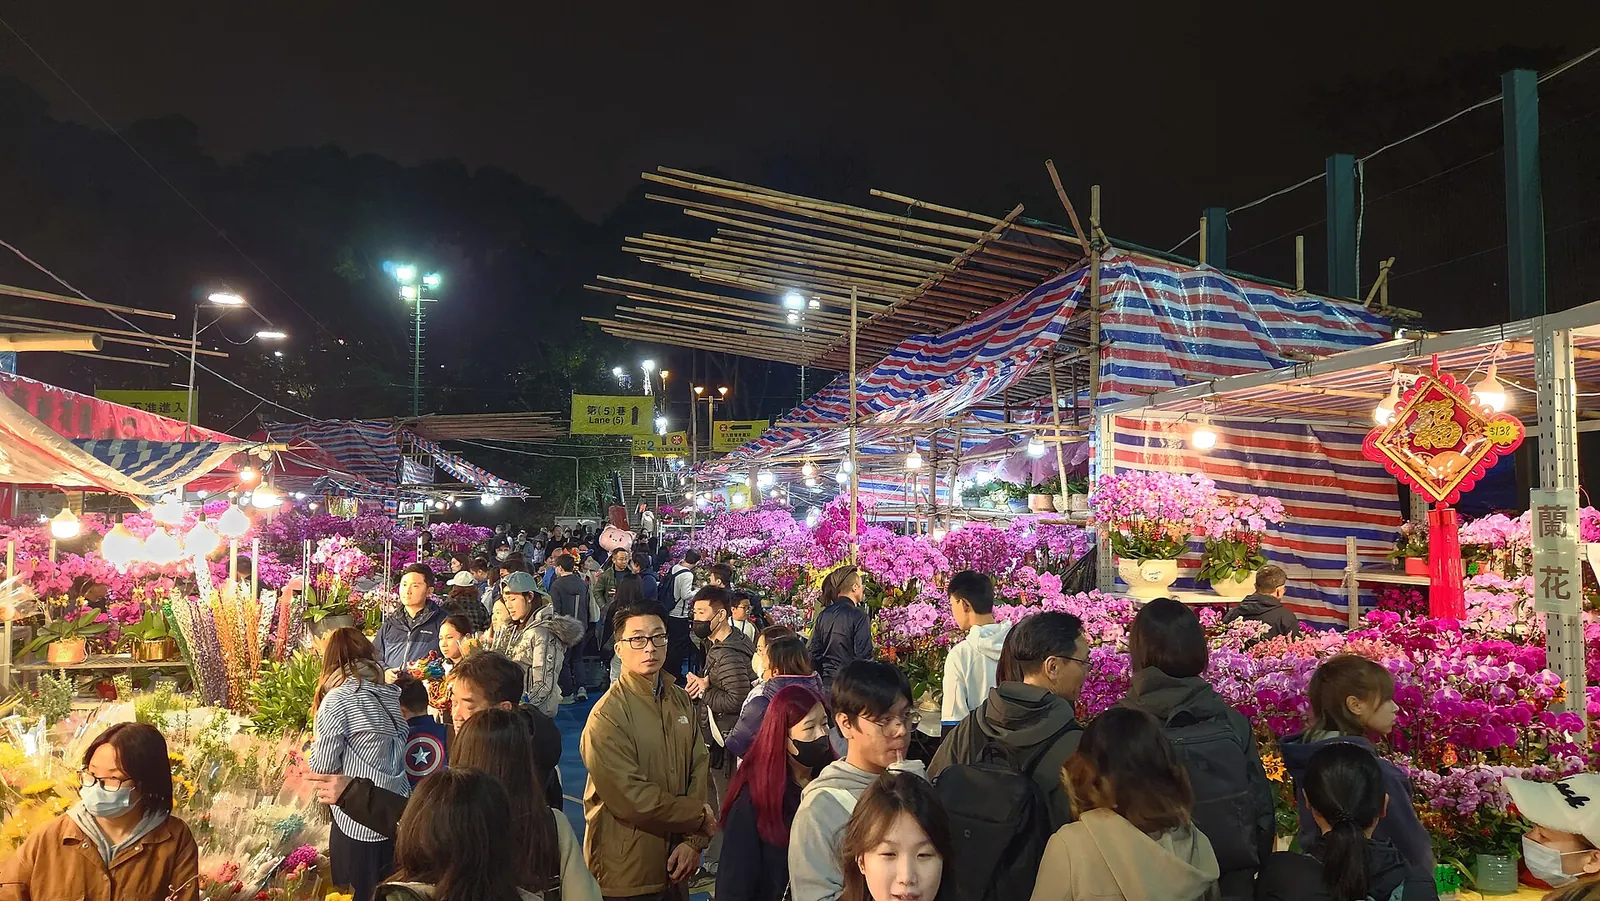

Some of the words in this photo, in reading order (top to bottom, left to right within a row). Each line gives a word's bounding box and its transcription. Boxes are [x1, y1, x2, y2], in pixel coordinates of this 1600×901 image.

[589, 416, 611, 425] Lane
[612, 416, 625, 426] (5)
[1537, 504, 1570, 600] 蘭花
